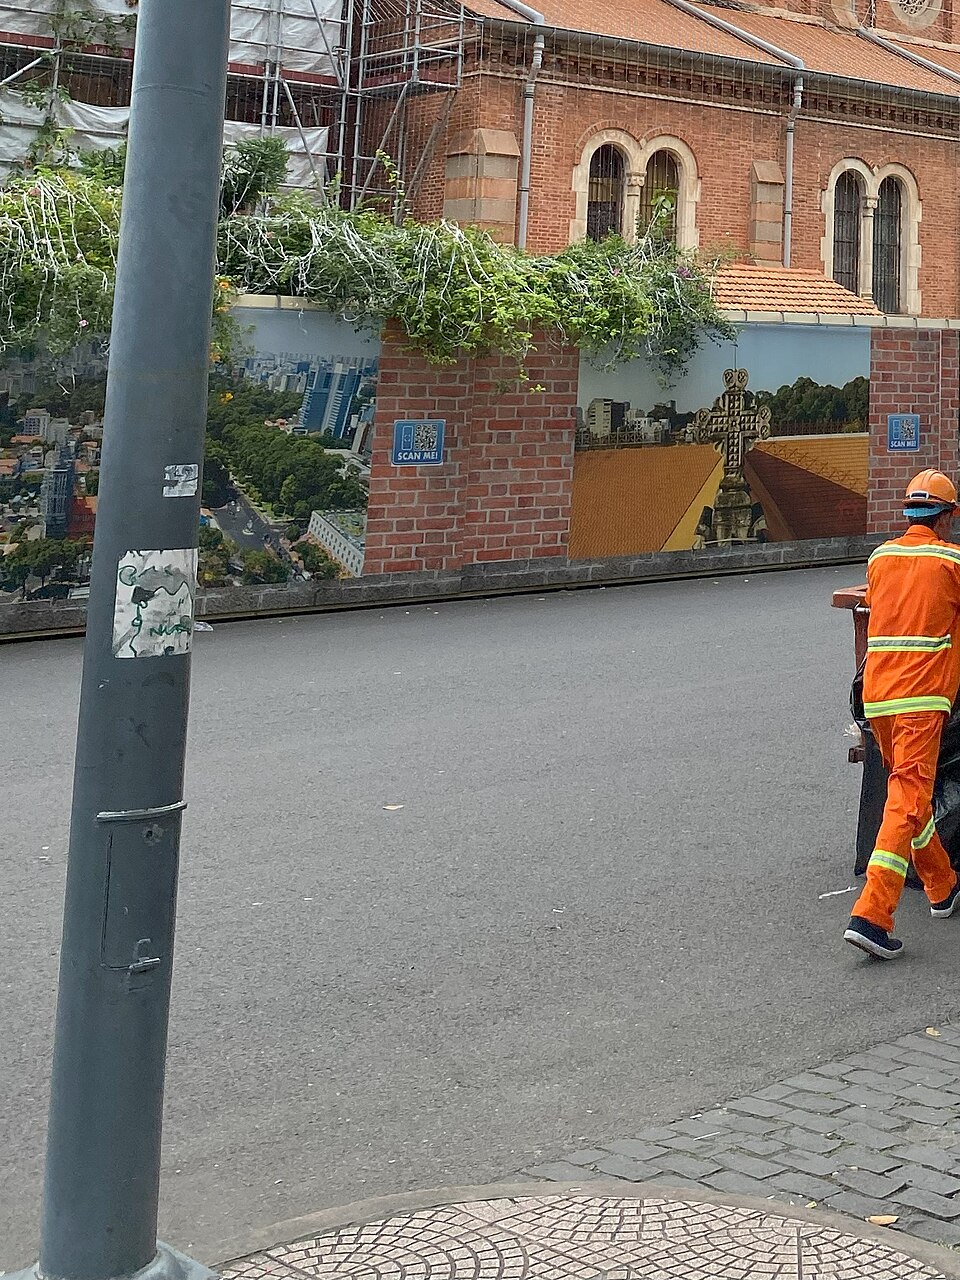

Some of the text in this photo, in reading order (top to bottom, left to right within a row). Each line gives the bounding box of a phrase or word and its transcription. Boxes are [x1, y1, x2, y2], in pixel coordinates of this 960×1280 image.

[890, 440, 905, 448] SCAN
[397, 451, 438, 461] SCAN ME!
